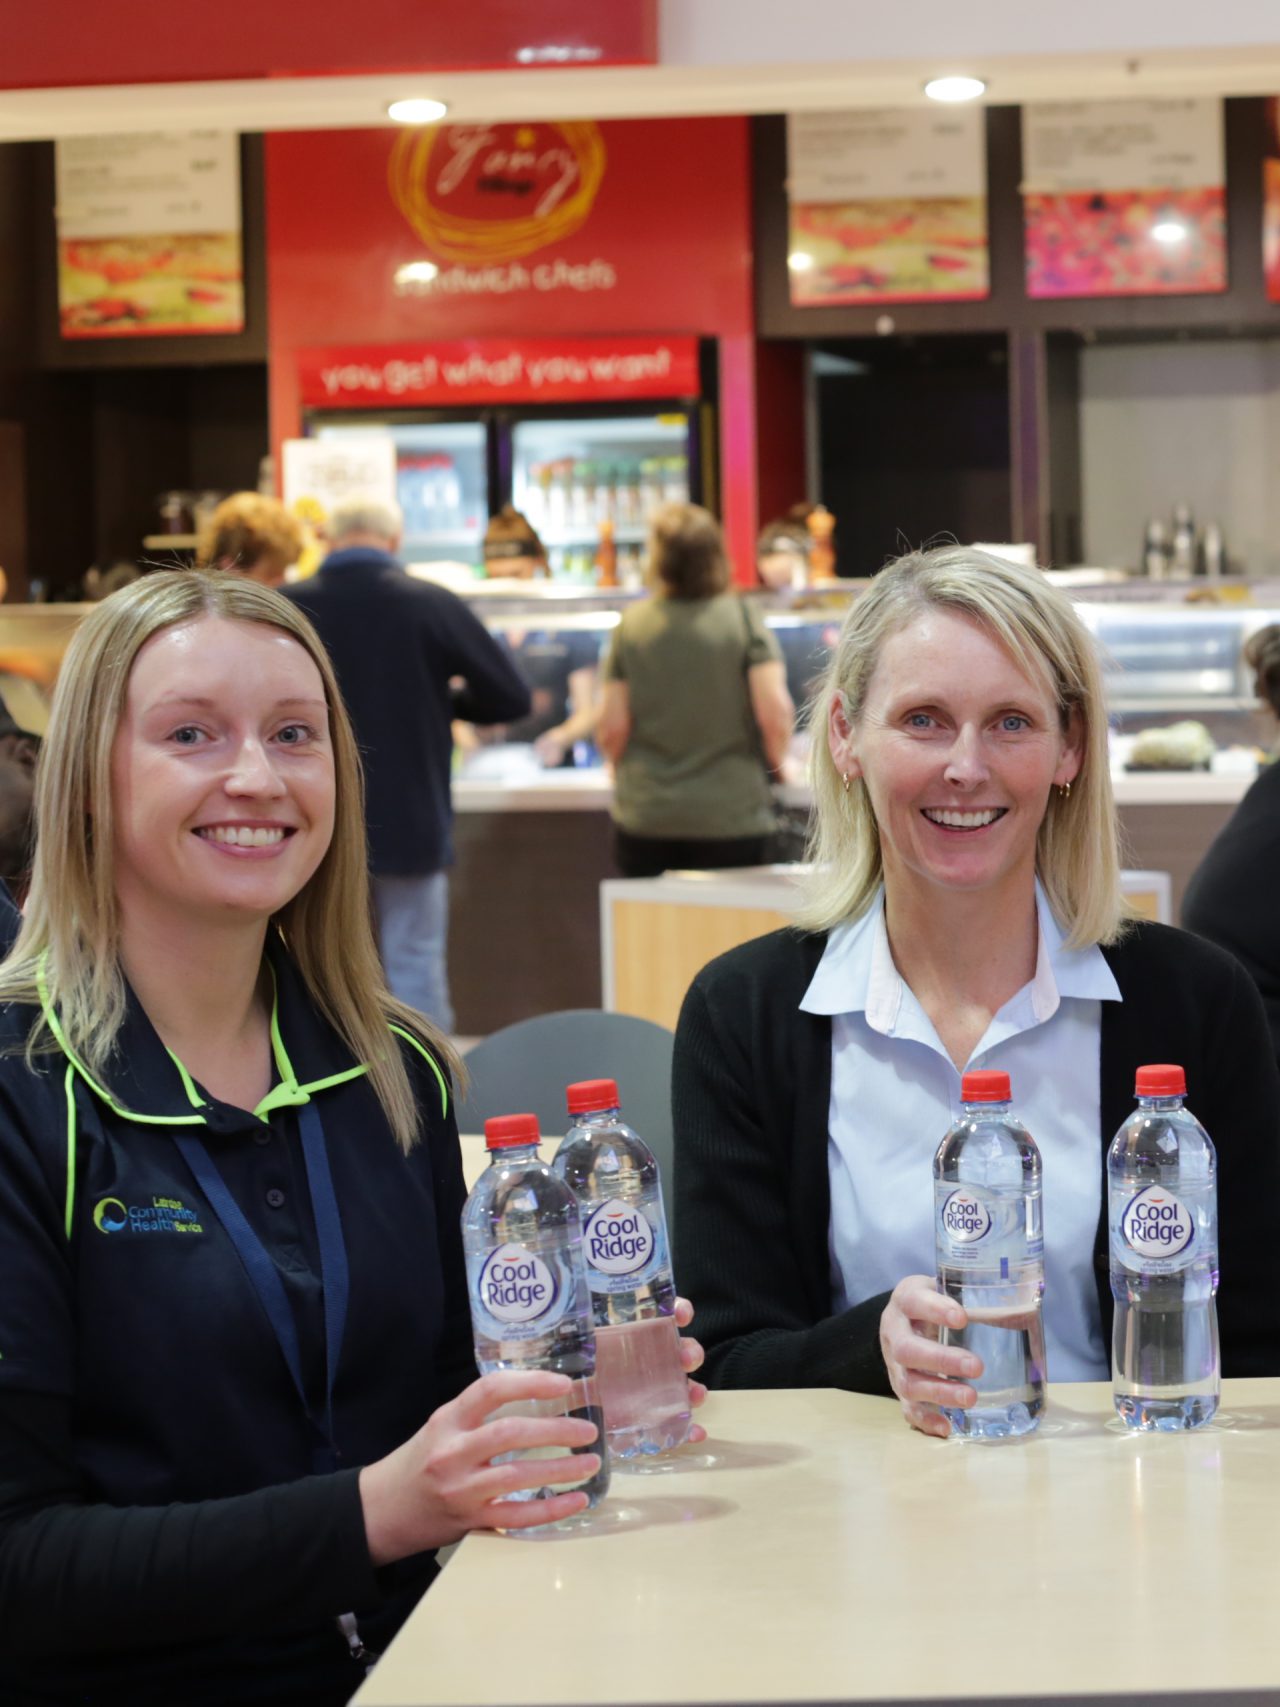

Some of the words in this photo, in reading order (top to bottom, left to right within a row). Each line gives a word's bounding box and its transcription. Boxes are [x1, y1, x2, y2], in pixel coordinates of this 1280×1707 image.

[320, 362, 383, 397] you
[384, 355, 437, 395] get
[441, 351, 523, 387] what
[525, 356, 588, 389] you
[589, 346, 671, 382] want
[128, 1206, 197, 1223] Community
[950, 1201, 978, 1216] Cool
[1135, 1203, 1178, 1221] Cool
[594, 1214, 639, 1239] Cool
[947, 1213, 983, 1234] Ridge
[1131, 1219, 1185, 1246] Ridge
[590, 1236, 647, 1260] Ridge
[490, 1260, 537, 1283] Cool
[487, 1282, 546, 1308] Ridge
